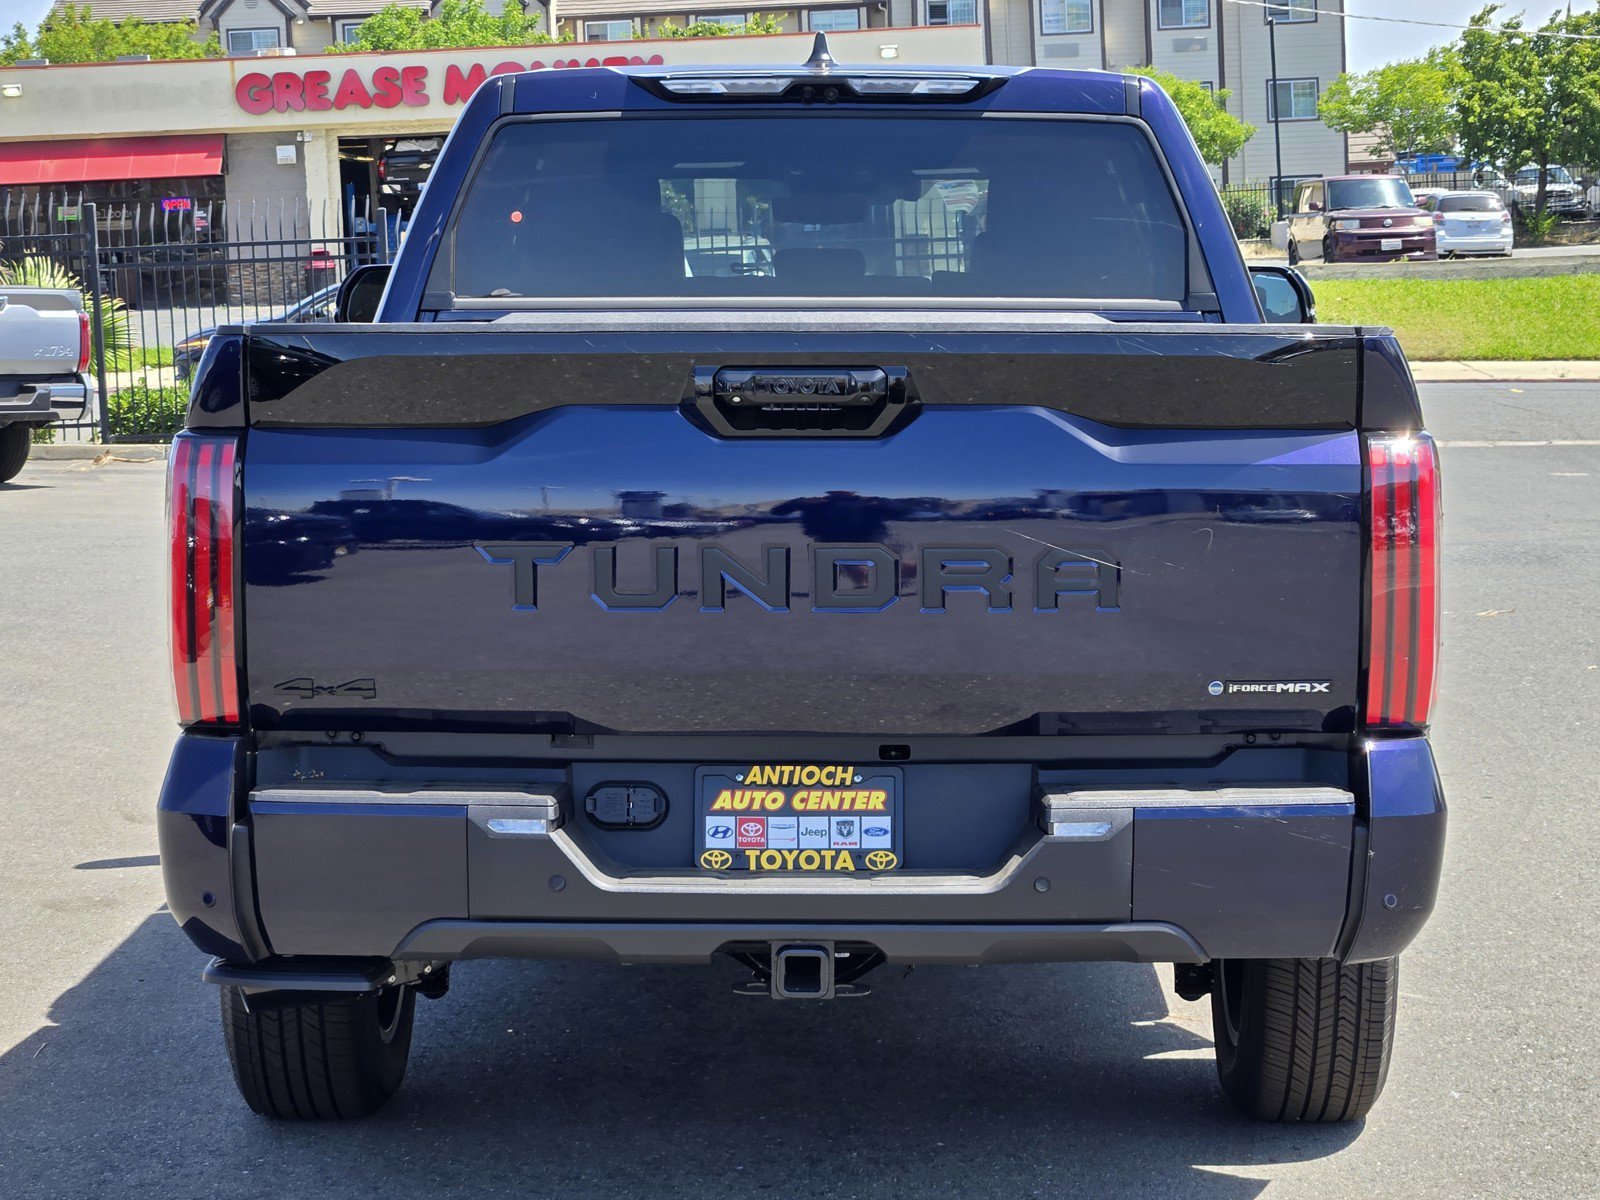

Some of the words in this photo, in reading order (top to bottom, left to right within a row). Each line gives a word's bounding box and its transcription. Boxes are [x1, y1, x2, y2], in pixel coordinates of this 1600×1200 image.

[235, 66, 430, 115] GREASE
[163, 199, 191, 209] OPEN
[762, 376, 841, 394] TOYOTA
[474, 541, 1122, 612] TUNDRA
[273, 678, 377, 699] 4x4
[744, 765, 853, 786] ANTIOCH
[710, 789, 785, 812] AUTO
[790, 789, 887, 812] CENTER
[801, 827, 827, 838] Jeep
[745, 850, 855, 870] TOYOTA
